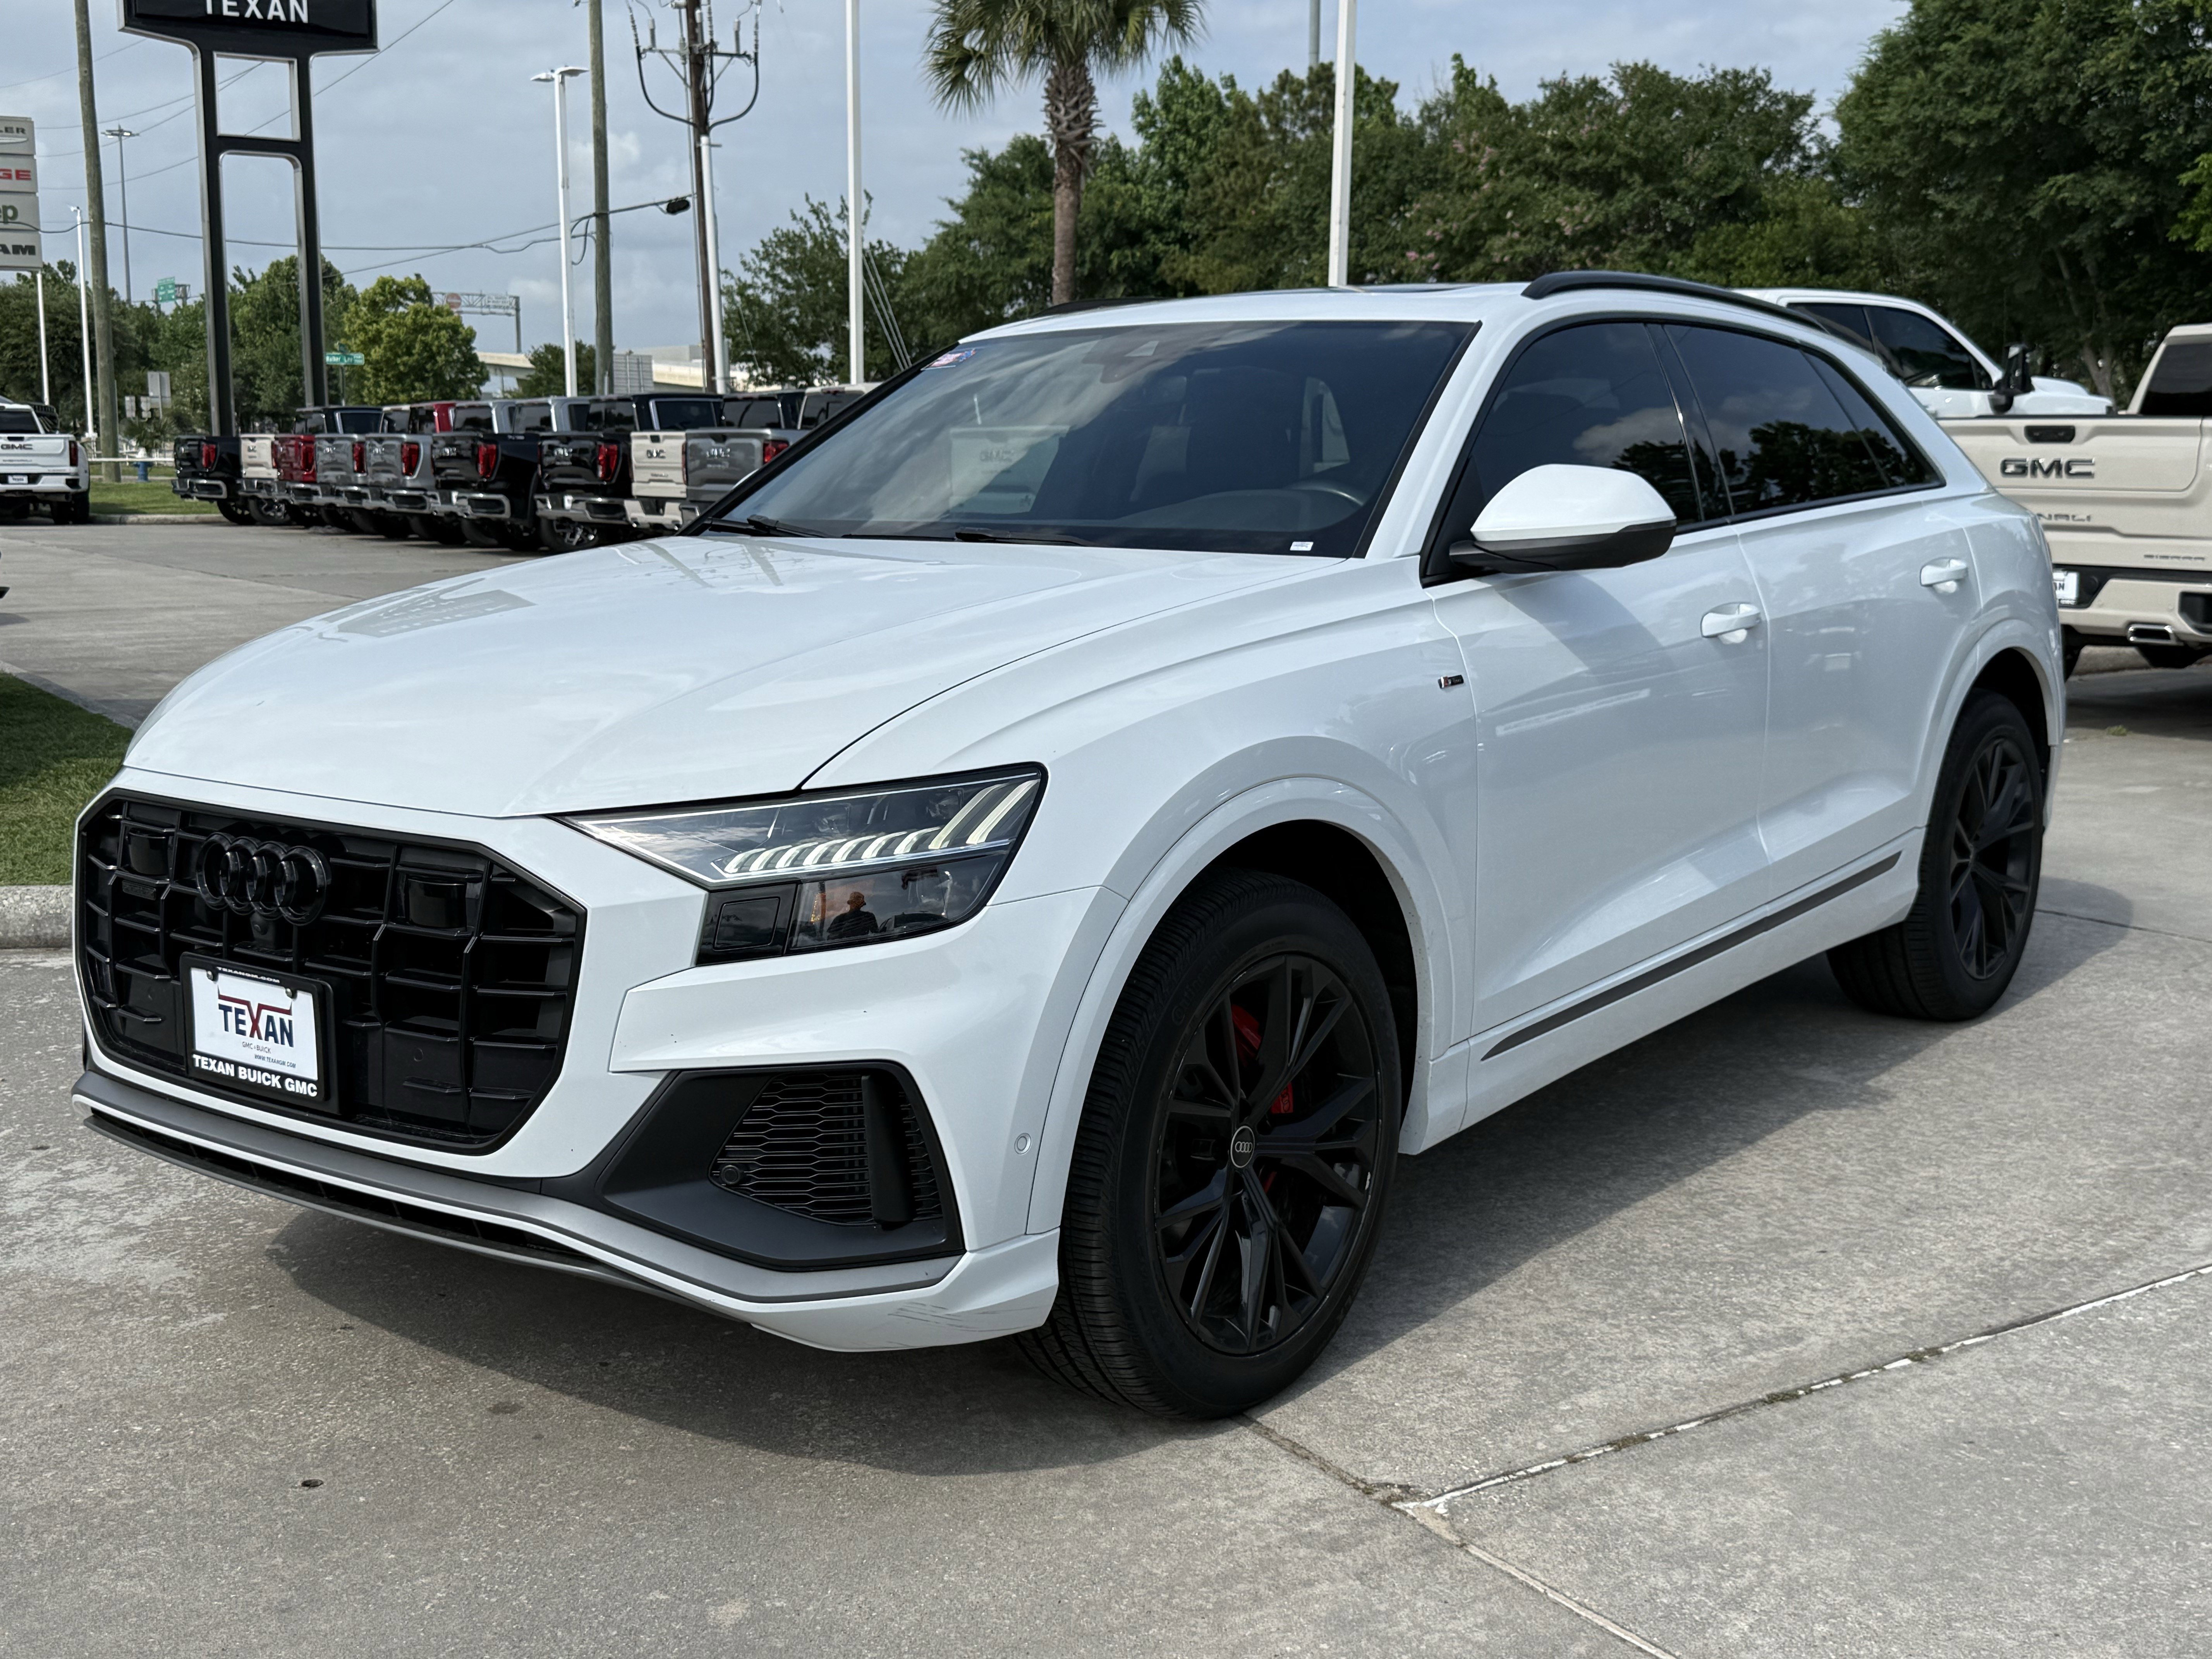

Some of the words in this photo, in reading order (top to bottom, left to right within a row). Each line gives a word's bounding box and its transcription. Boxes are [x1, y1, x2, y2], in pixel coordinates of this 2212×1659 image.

[2000, 458, 2095, 479] GMC
[218, 1000, 294, 1048] TEXAN
[242, 1041, 253, 1049] GMC
[256, 1045, 271, 1054] BUICK
[192, 1054, 235, 1077] TEXAN
[238, 1066, 282, 1089] BUICK
[284, 1078, 318, 1097] GMC
